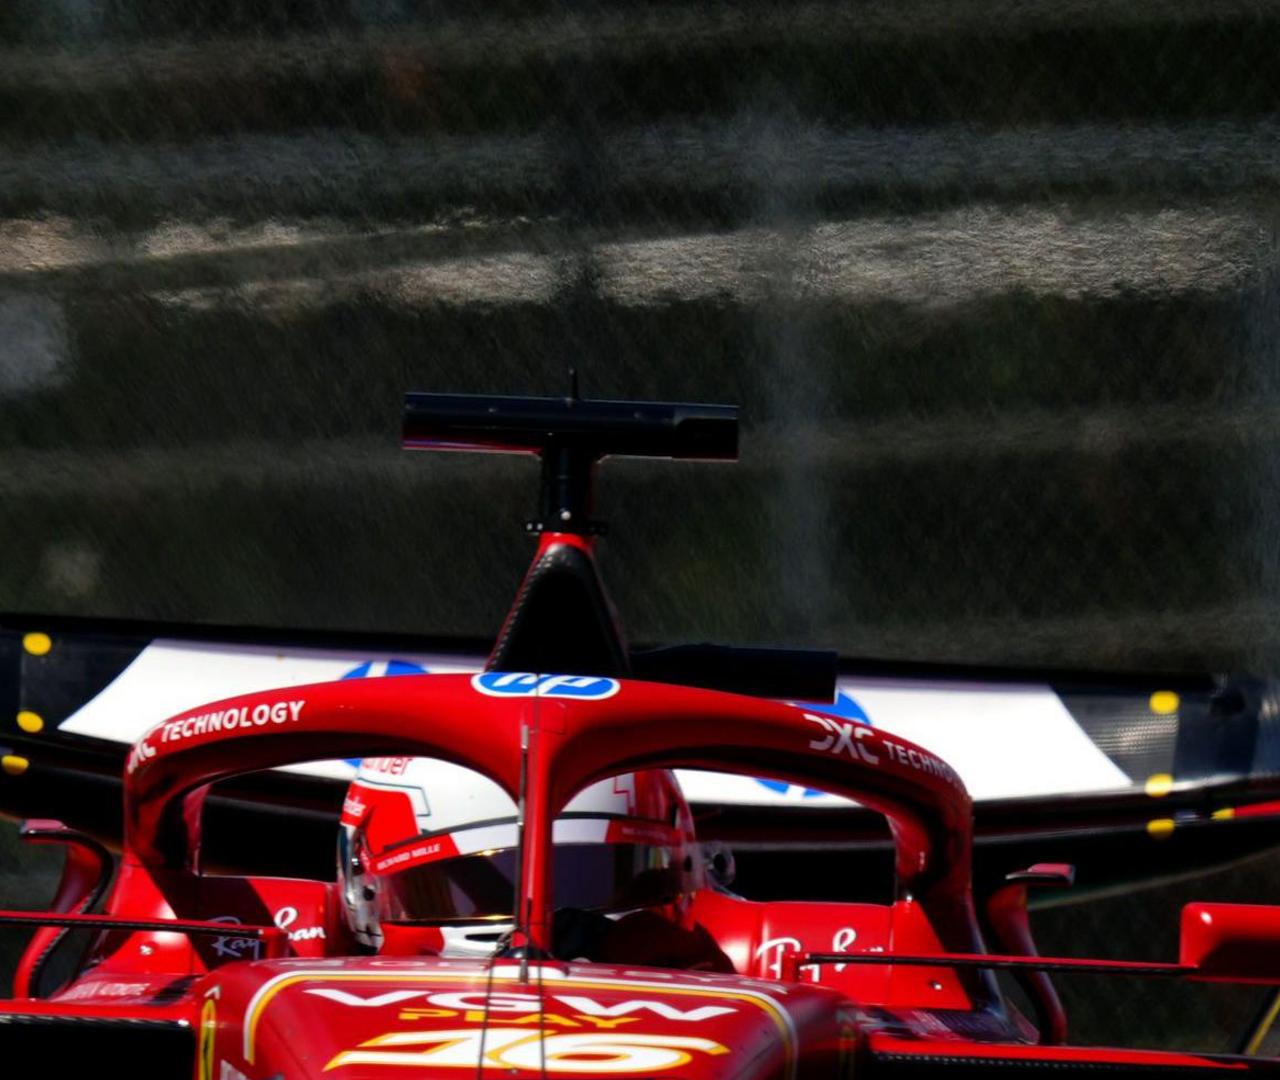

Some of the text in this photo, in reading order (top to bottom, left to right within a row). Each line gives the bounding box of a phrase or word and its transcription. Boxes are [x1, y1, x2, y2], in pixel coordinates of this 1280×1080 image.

[161, 700, 305, 743] TECHNOLOGY
[802, 713, 879, 766] DXC
[304, 987, 737, 1022] VGW
[399, 1008, 641, 1030] PLAY
[322, 1027, 732, 1074] 16
